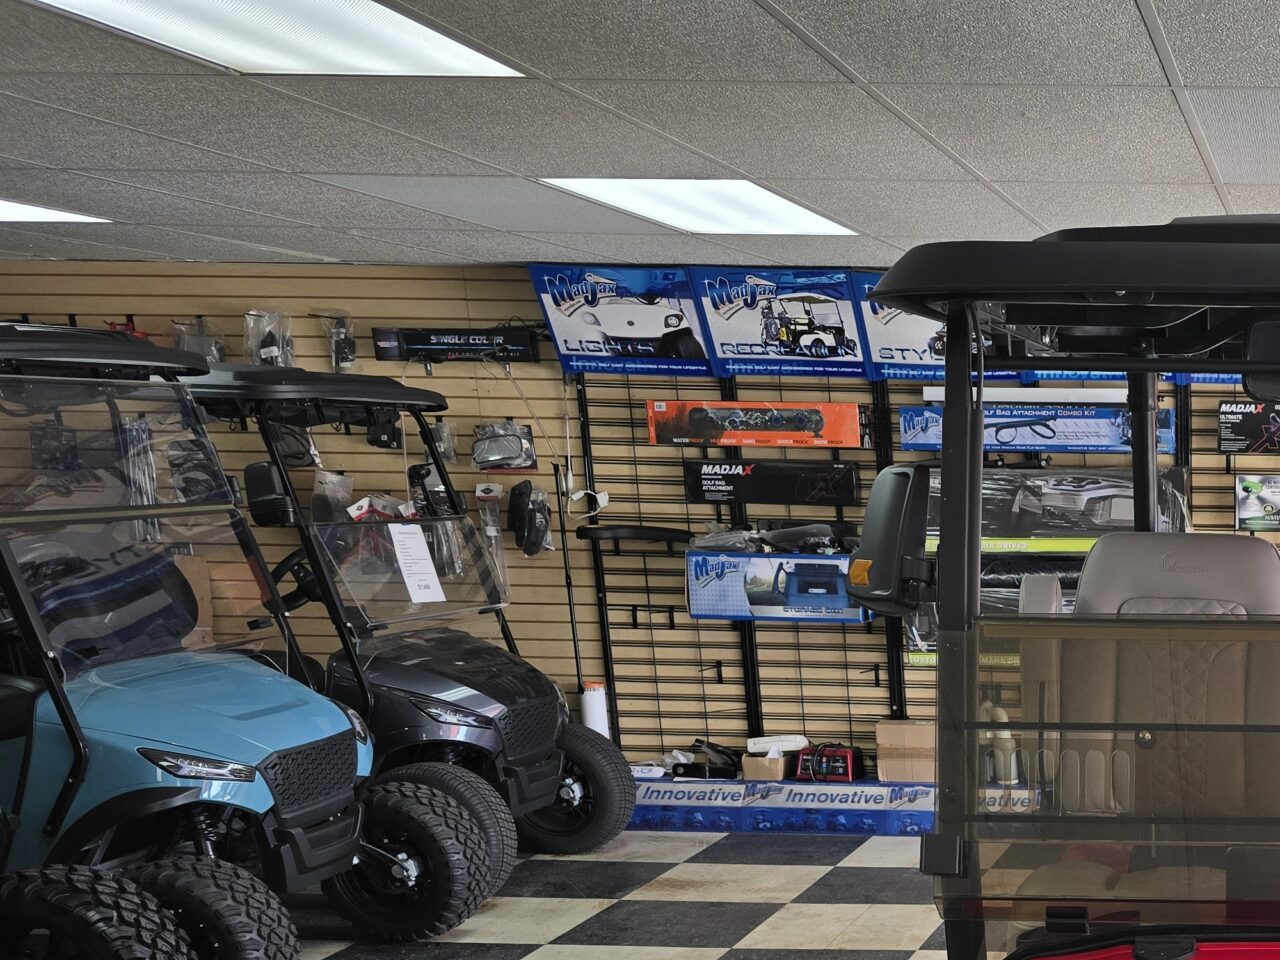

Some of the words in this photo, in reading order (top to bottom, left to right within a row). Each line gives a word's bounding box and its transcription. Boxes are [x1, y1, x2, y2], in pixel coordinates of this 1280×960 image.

[545, 273, 617, 307] MadJax
[705, 276, 777, 310] MadJax
[564, 339, 654, 353] LIGHTS
[879, 347, 945, 361] STYL
[1220, 403, 1265, 413] MADJAX
[902, 411, 940, 433] MadJax
[701, 464, 756, 476] MADJAX
[694, 555, 740, 581] MadJax
[642, 786, 742, 802] Innovative
[743, 783, 785, 800] MadJax
[786, 788, 885, 804] Innovative
[889, 786, 932, 803] MadJax
[977, 795, 1031, 808] vative
